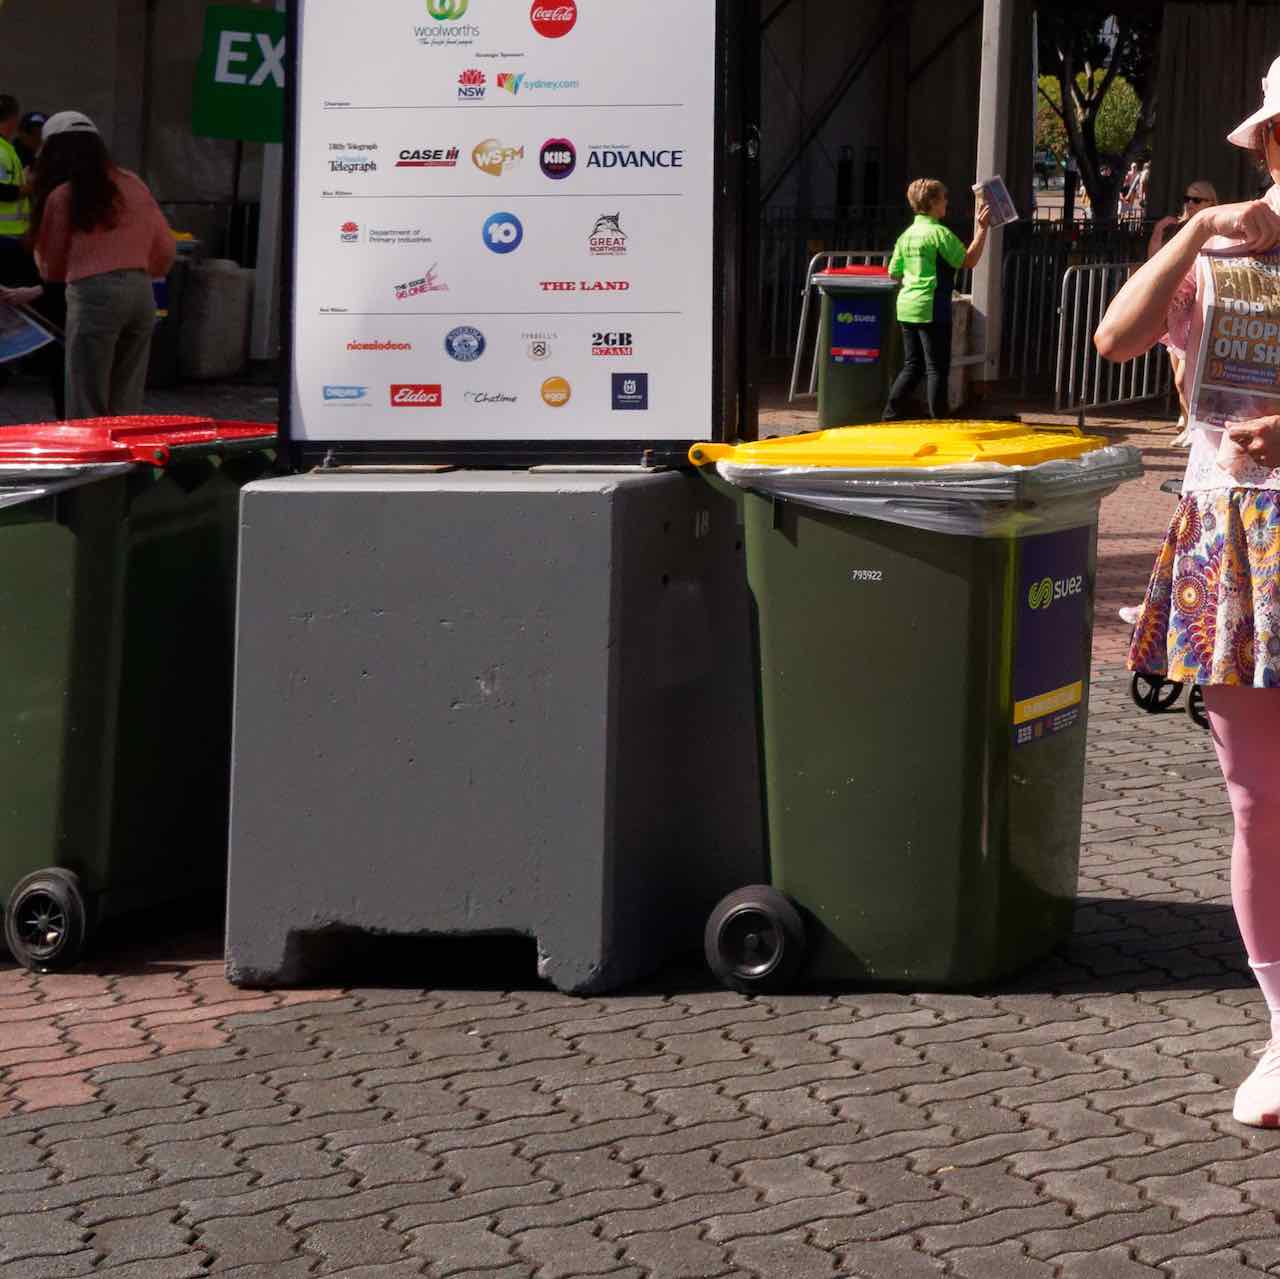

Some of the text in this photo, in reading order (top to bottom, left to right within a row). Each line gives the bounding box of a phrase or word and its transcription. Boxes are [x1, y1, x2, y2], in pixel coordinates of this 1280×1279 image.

[458, 87, 486, 97] NSW
[524, 80, 579, 91] sydney.com
[399, 149, 443, 160] CASE
[586, 150, 684, 168] ADVANCE
[328, 161, 377, 173] Telegraph
[488, 222, 518, 244] 10
[590, 237, 625, 246] GREAT
[540, 280, 630, 291] THE LAND
[1221, 297, 1264, 315] TOP
[591, 332, 632, 346] 2GB
[1215, 339, 1247, 361] ON
[394, 388, 439, 403] Elders
[1054, 576, 1082, 599] suez
